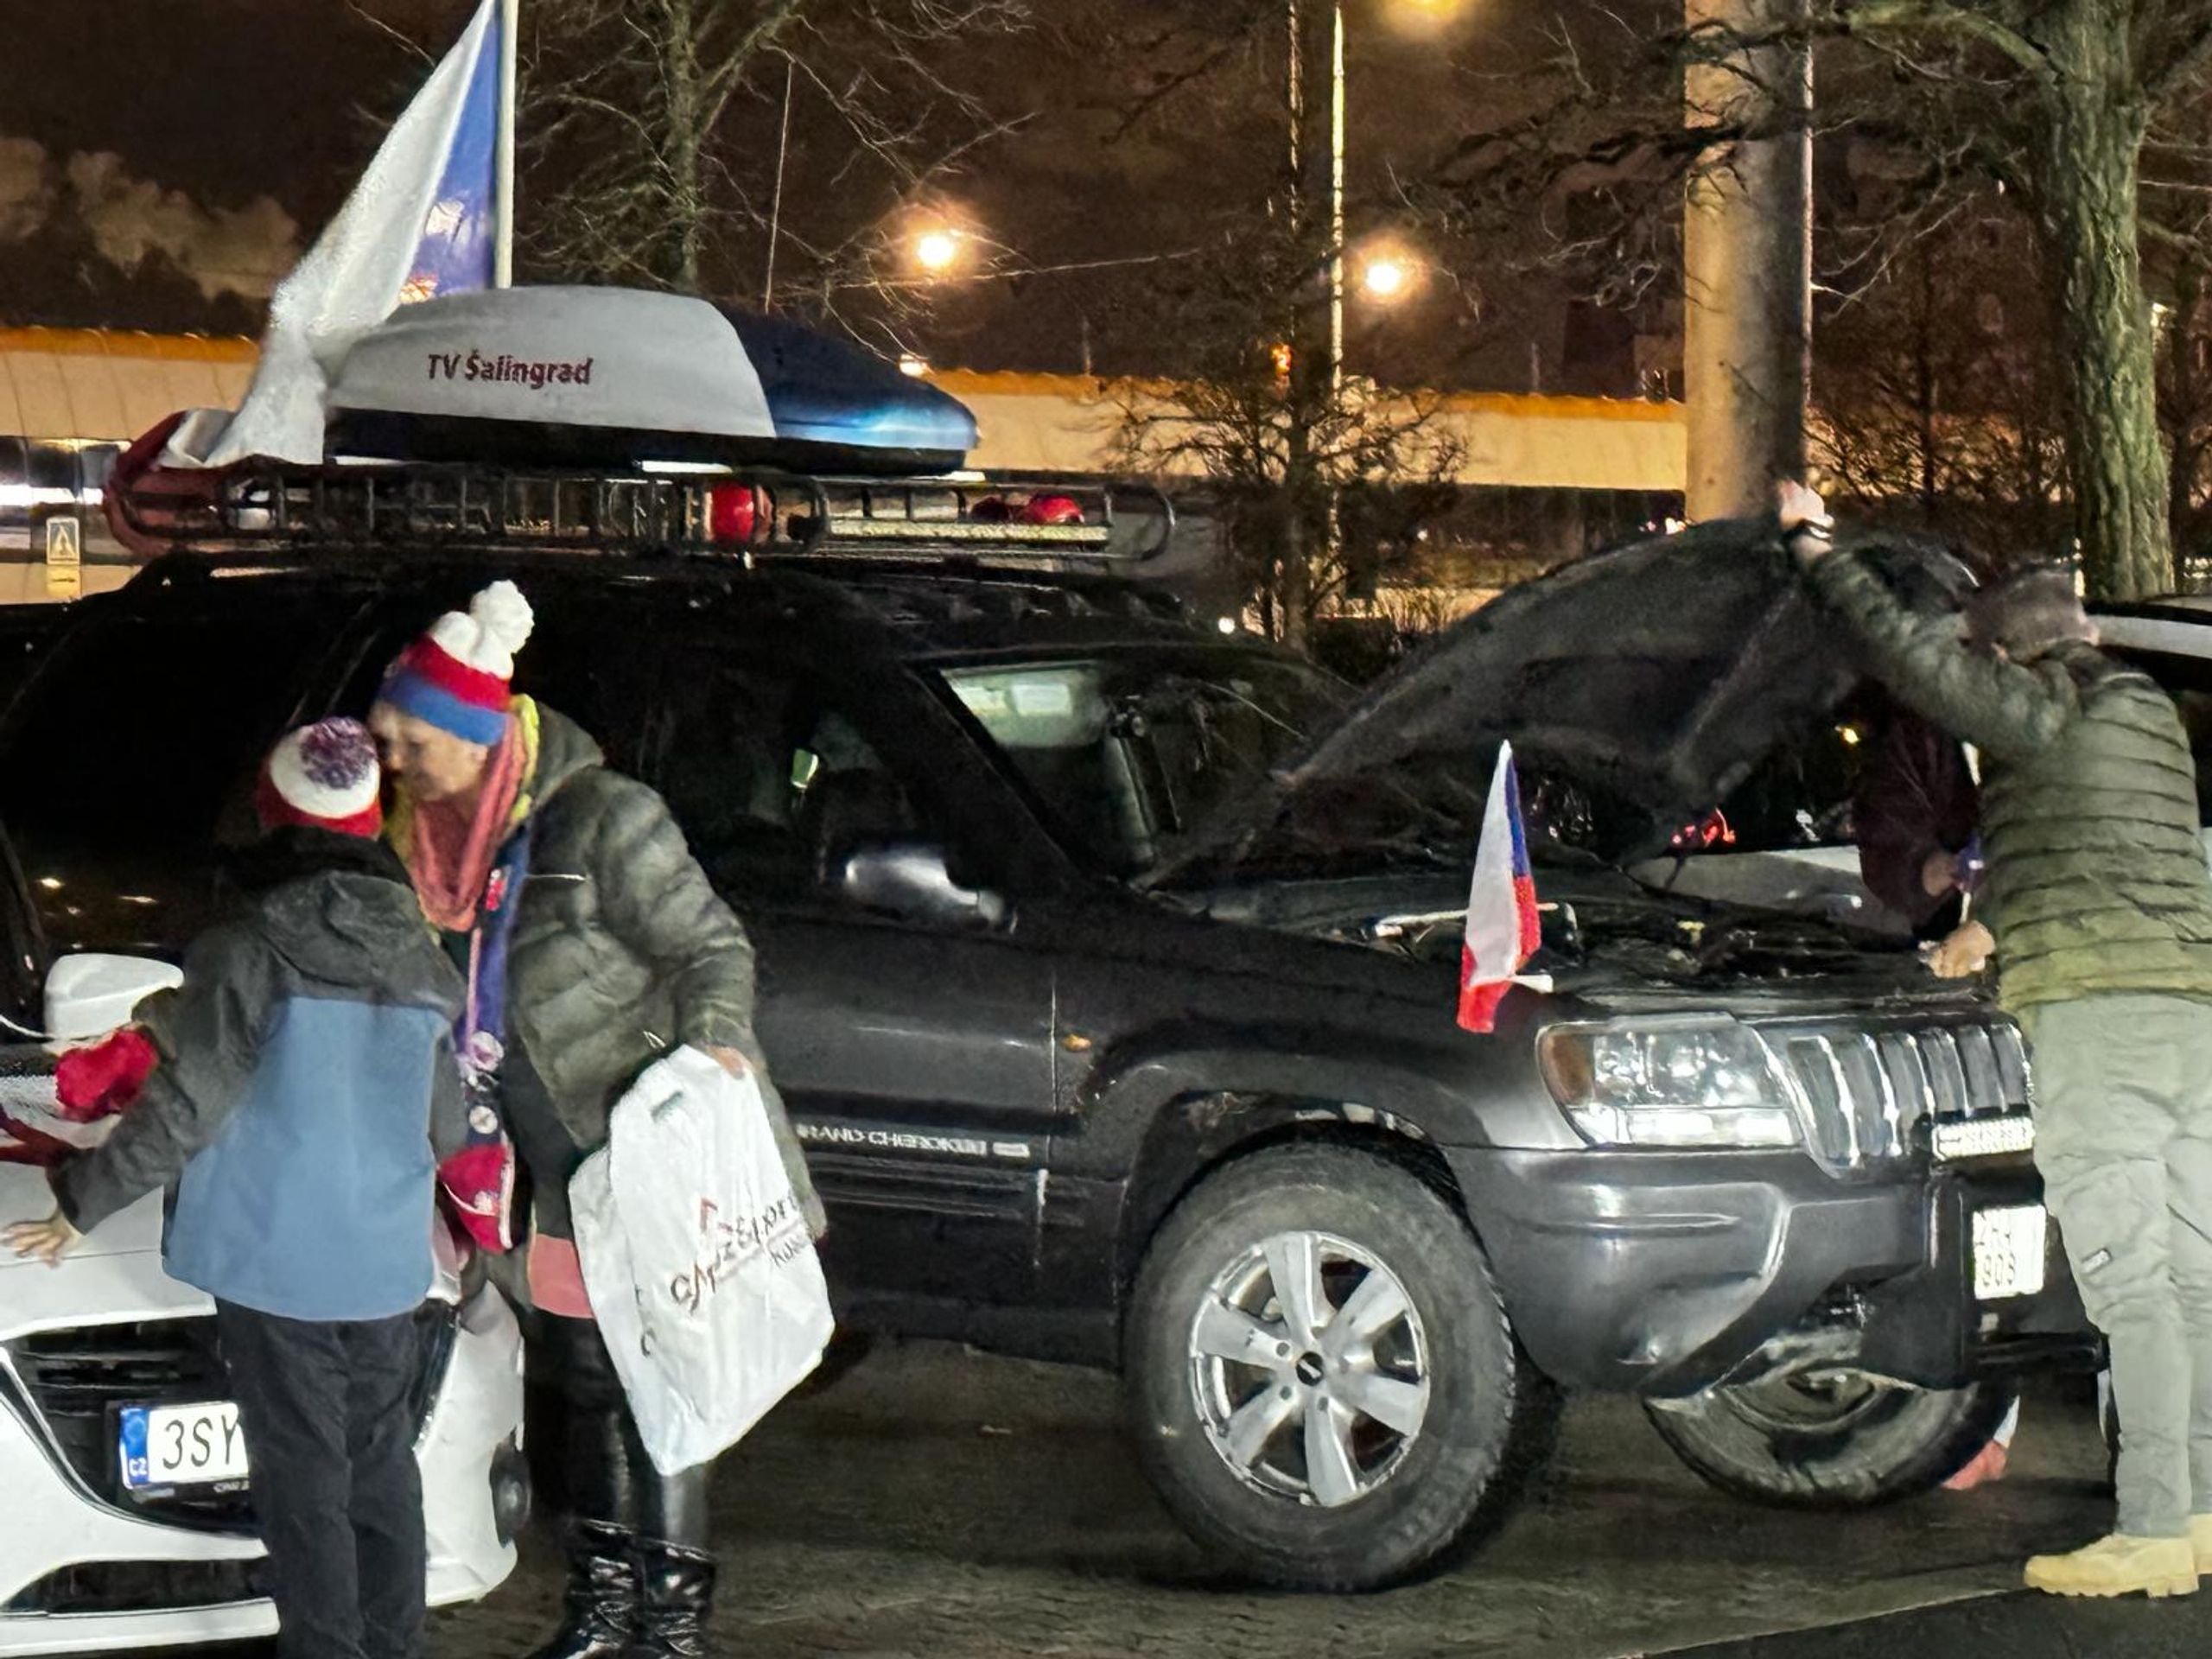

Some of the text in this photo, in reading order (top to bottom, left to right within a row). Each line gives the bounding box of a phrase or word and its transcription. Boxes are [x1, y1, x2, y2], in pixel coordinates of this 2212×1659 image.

[429, 349, 594, 390] TV Šalingrad
[162, 1414, 238, 1470] 3SY
